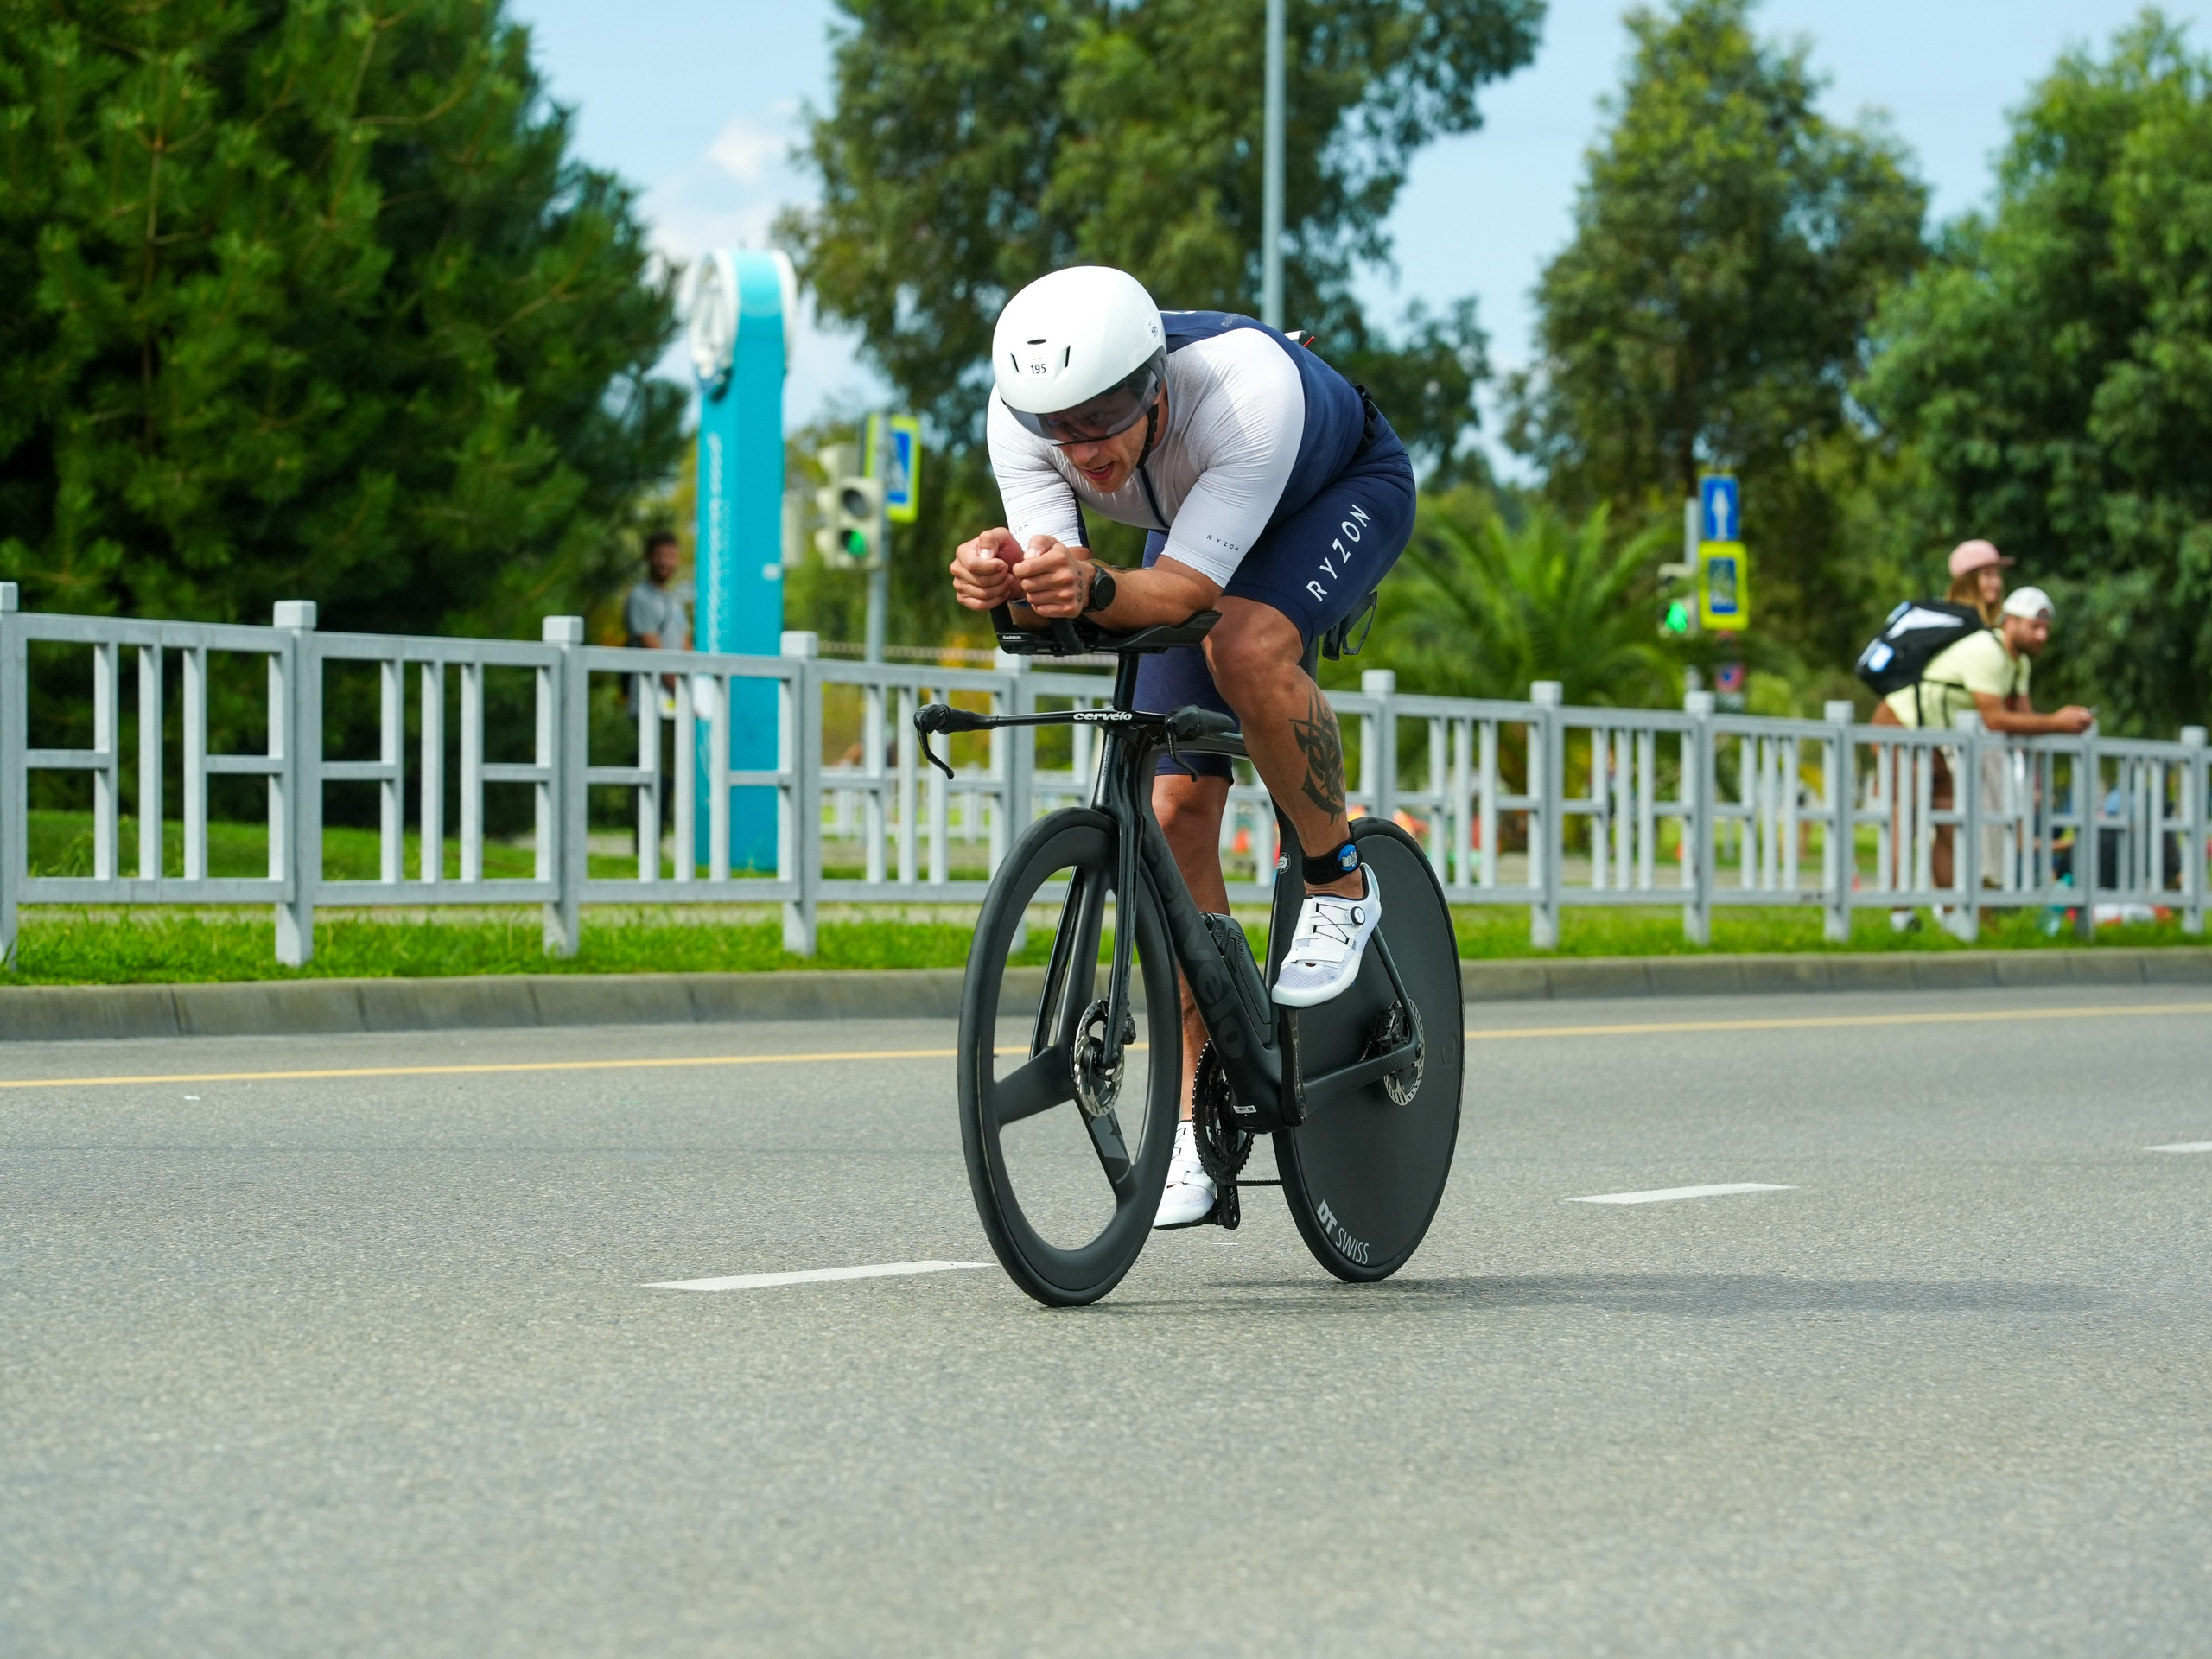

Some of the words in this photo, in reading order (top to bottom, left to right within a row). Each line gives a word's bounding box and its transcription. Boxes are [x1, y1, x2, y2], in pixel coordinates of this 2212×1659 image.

[1030, 363, 1046, 374] 195
[1206, 534, 1240, 551] RYZON
[1306, 504, 1371, 602] RYZON
[1073, 711, 1133, 721] cervélo
[1316, 1198, 1338, 1235] DT
[1335, 1227, 1370, 1265] SWISS
